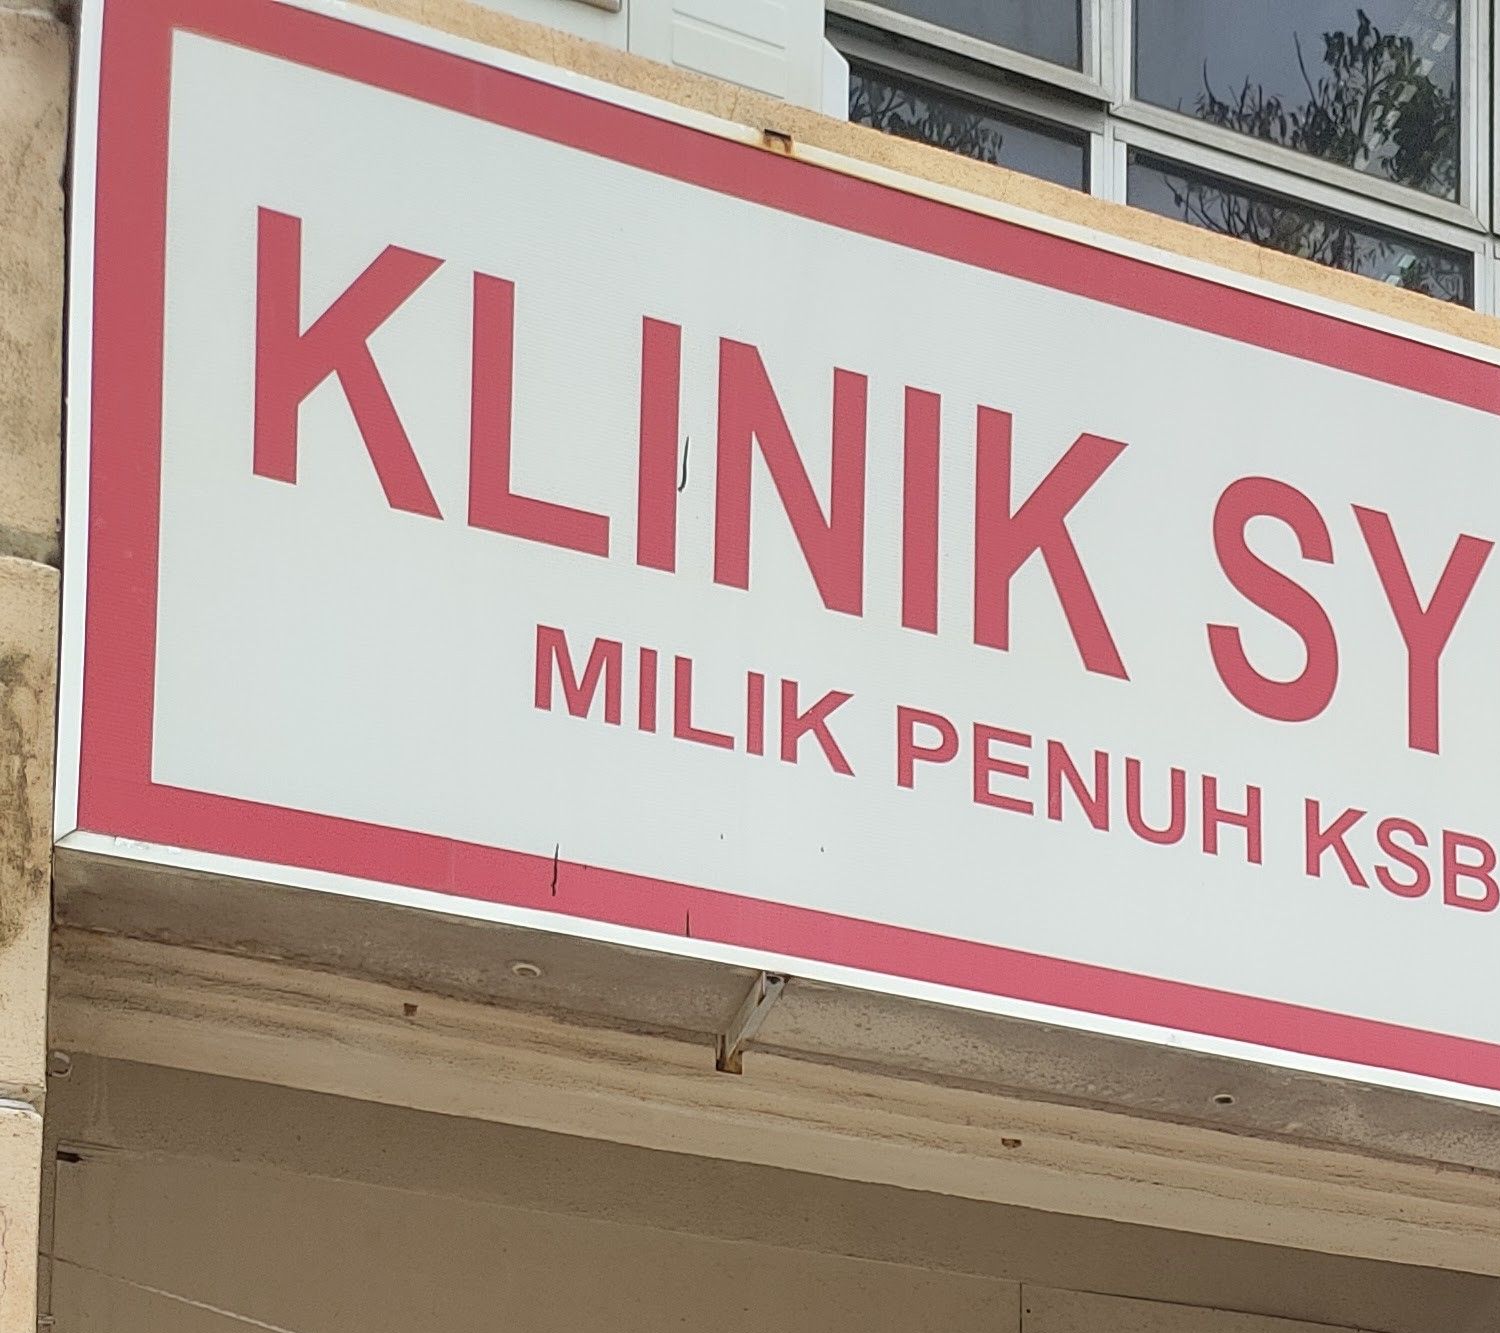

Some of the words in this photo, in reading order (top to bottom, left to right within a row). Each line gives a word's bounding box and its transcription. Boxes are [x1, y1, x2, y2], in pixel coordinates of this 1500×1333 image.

[254, 206, 1130, 681] KLINIK
[534, 624, 856, 777] MILIK
[896, 704, 1265, 867] PENUH
[1304, 798, 1500, 912] KSB
